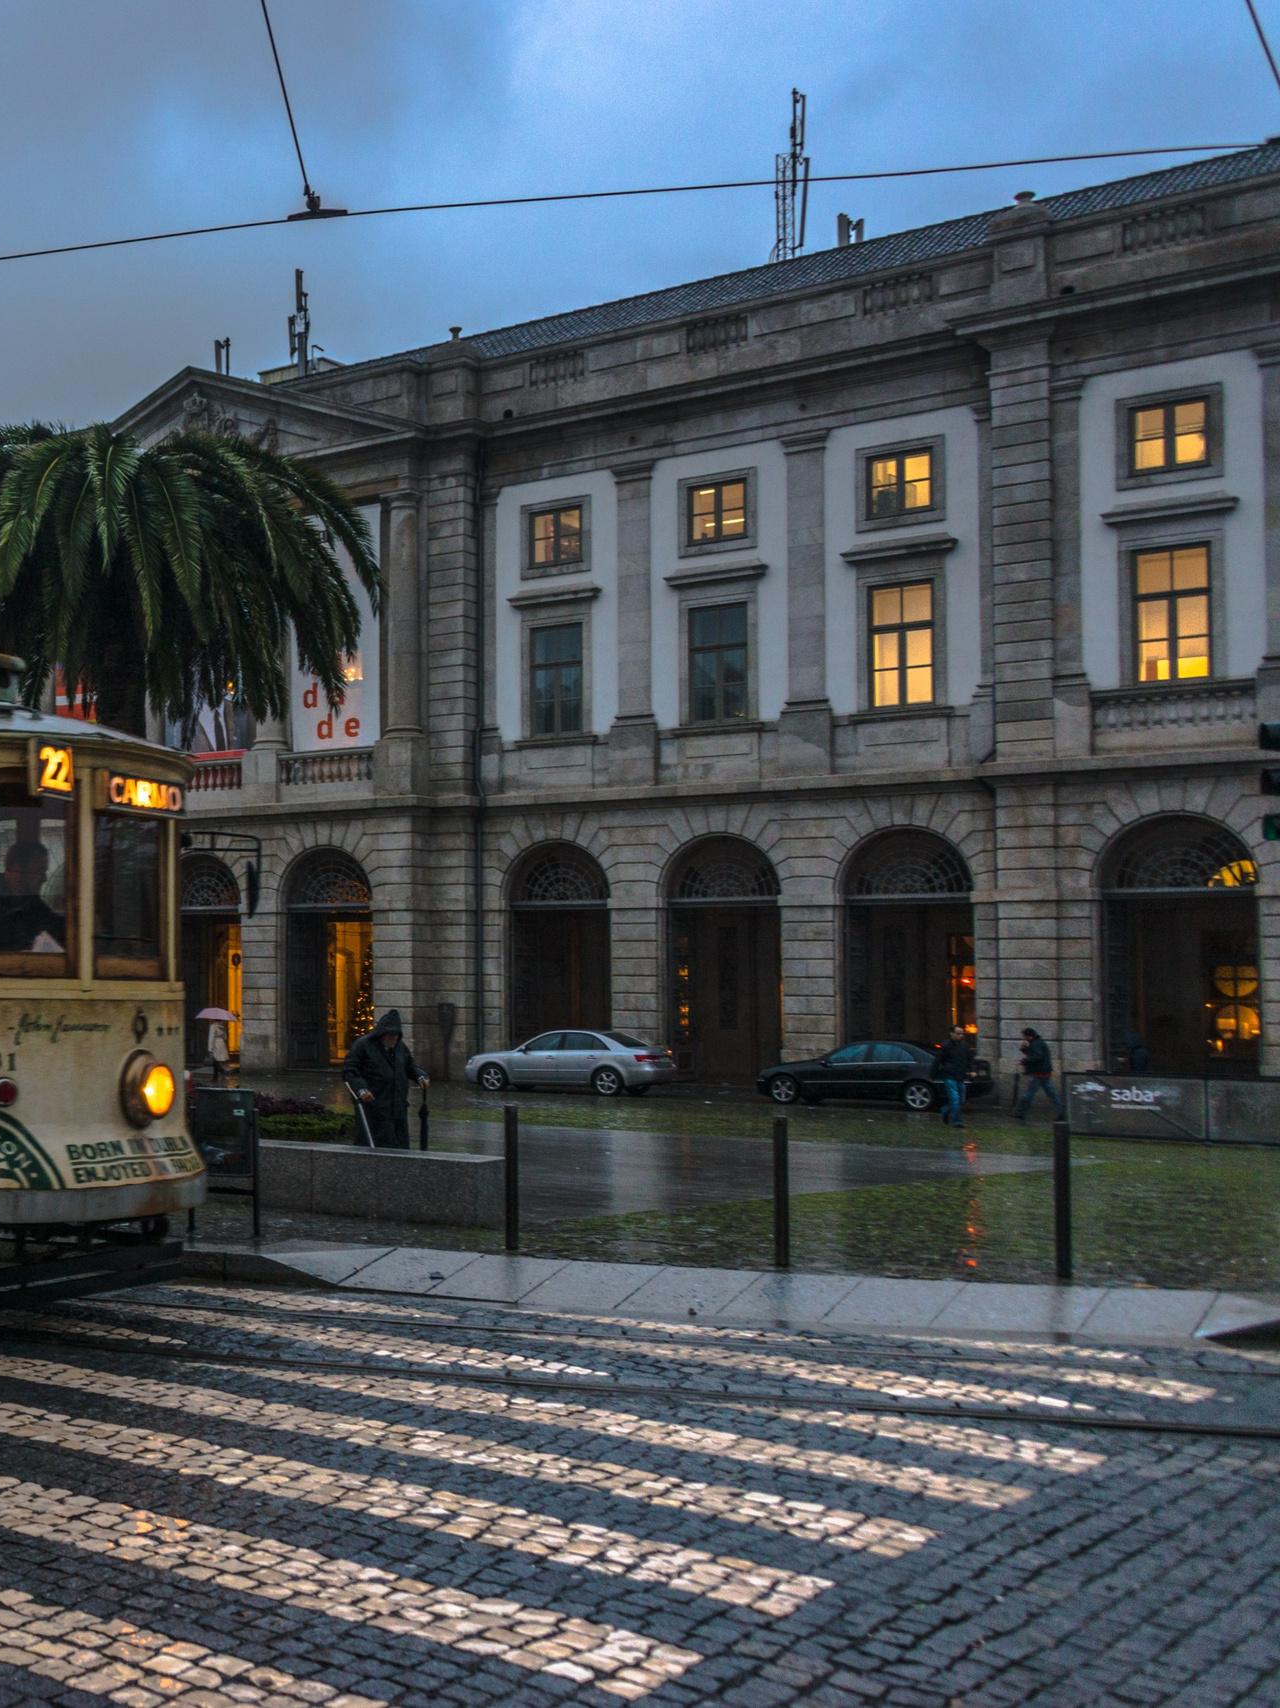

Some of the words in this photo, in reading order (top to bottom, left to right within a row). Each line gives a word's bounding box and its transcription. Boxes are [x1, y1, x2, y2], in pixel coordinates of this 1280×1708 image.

[38, 746, 72, 792] 22
[109, 775, 182, 811] CARMO
[1110, 1086, 1155, 1103] saba
[65, 1140, 125, 1161] BORN
[72, 1161, 152, 1184] ENJOYED
